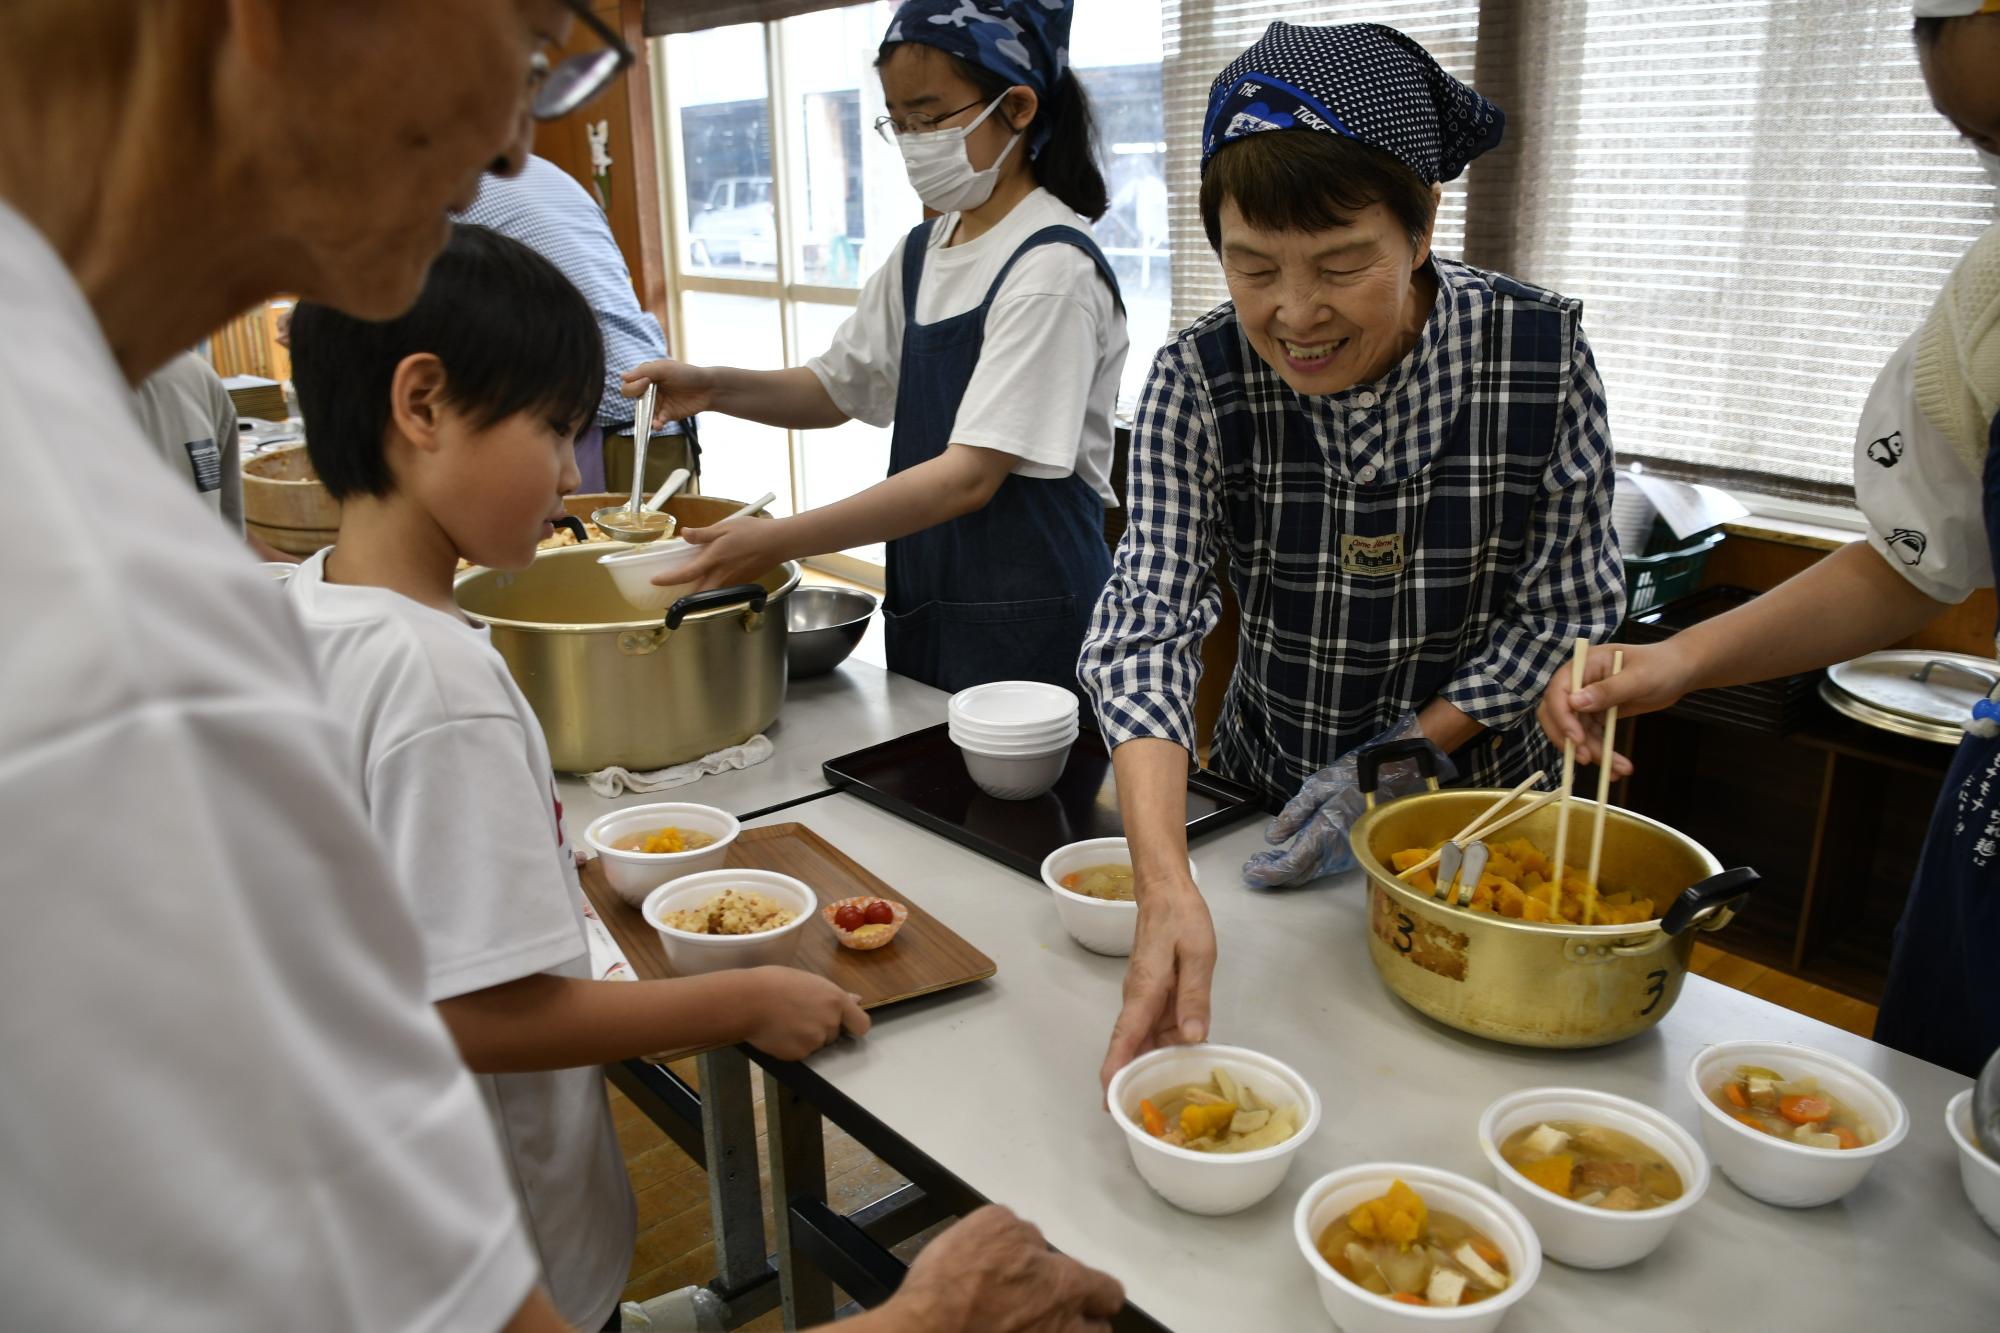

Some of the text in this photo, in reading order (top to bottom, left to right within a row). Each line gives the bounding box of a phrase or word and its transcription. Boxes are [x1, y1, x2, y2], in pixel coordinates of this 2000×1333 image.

[1238, 82, 1262, 98] THE
[1393, 913, 1414, 952] 3
[1641, 970, 1668, 1015] 3
